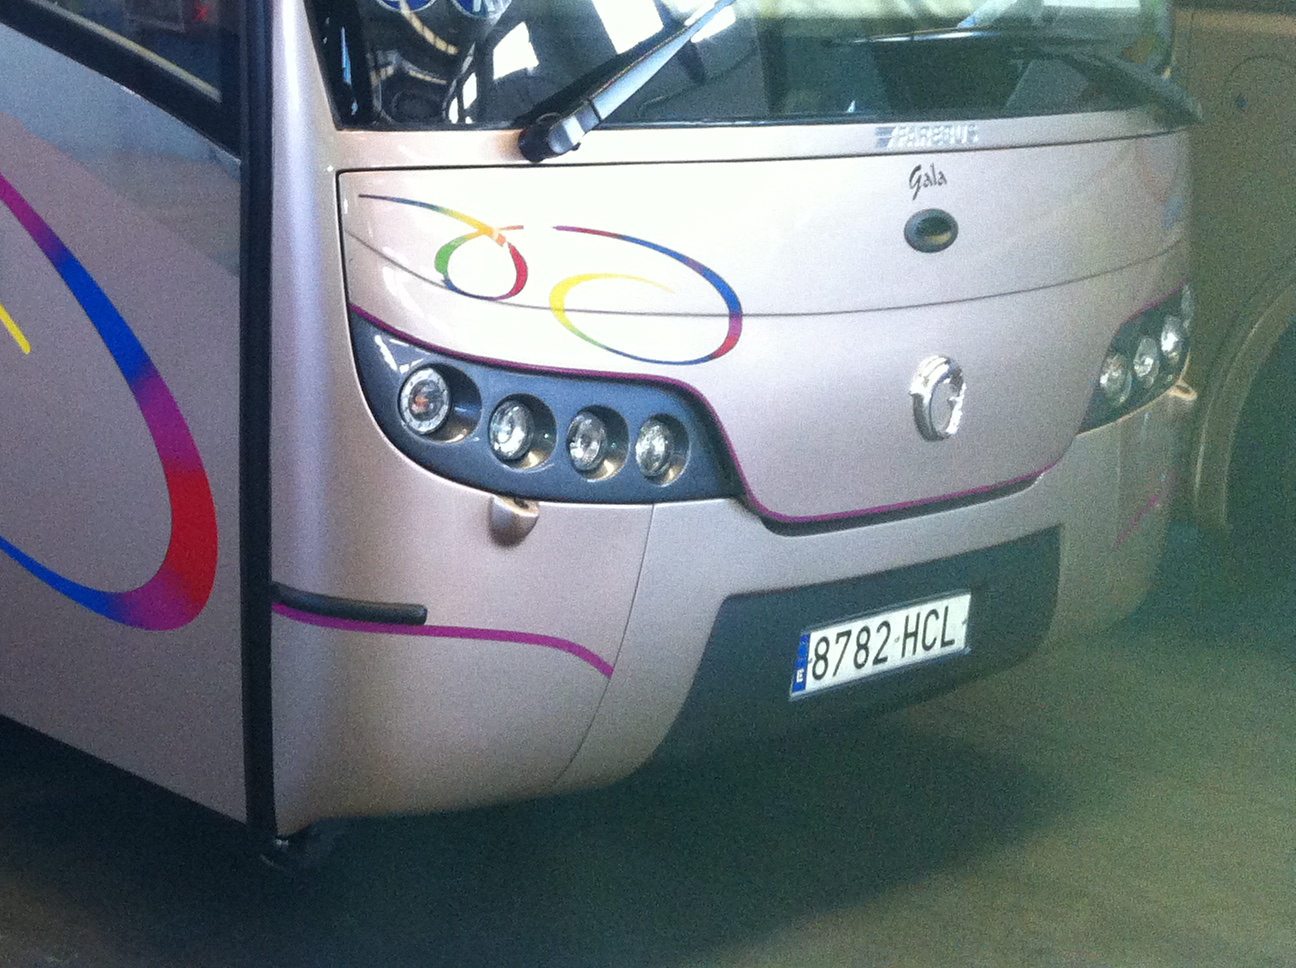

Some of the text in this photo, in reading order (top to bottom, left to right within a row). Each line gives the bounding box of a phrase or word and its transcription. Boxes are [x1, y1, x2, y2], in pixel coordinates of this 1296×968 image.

[909, 162, 948, 201] Gala
[811, 620, 892, 681] 8782
[901, 605, 955, 658] HCL
